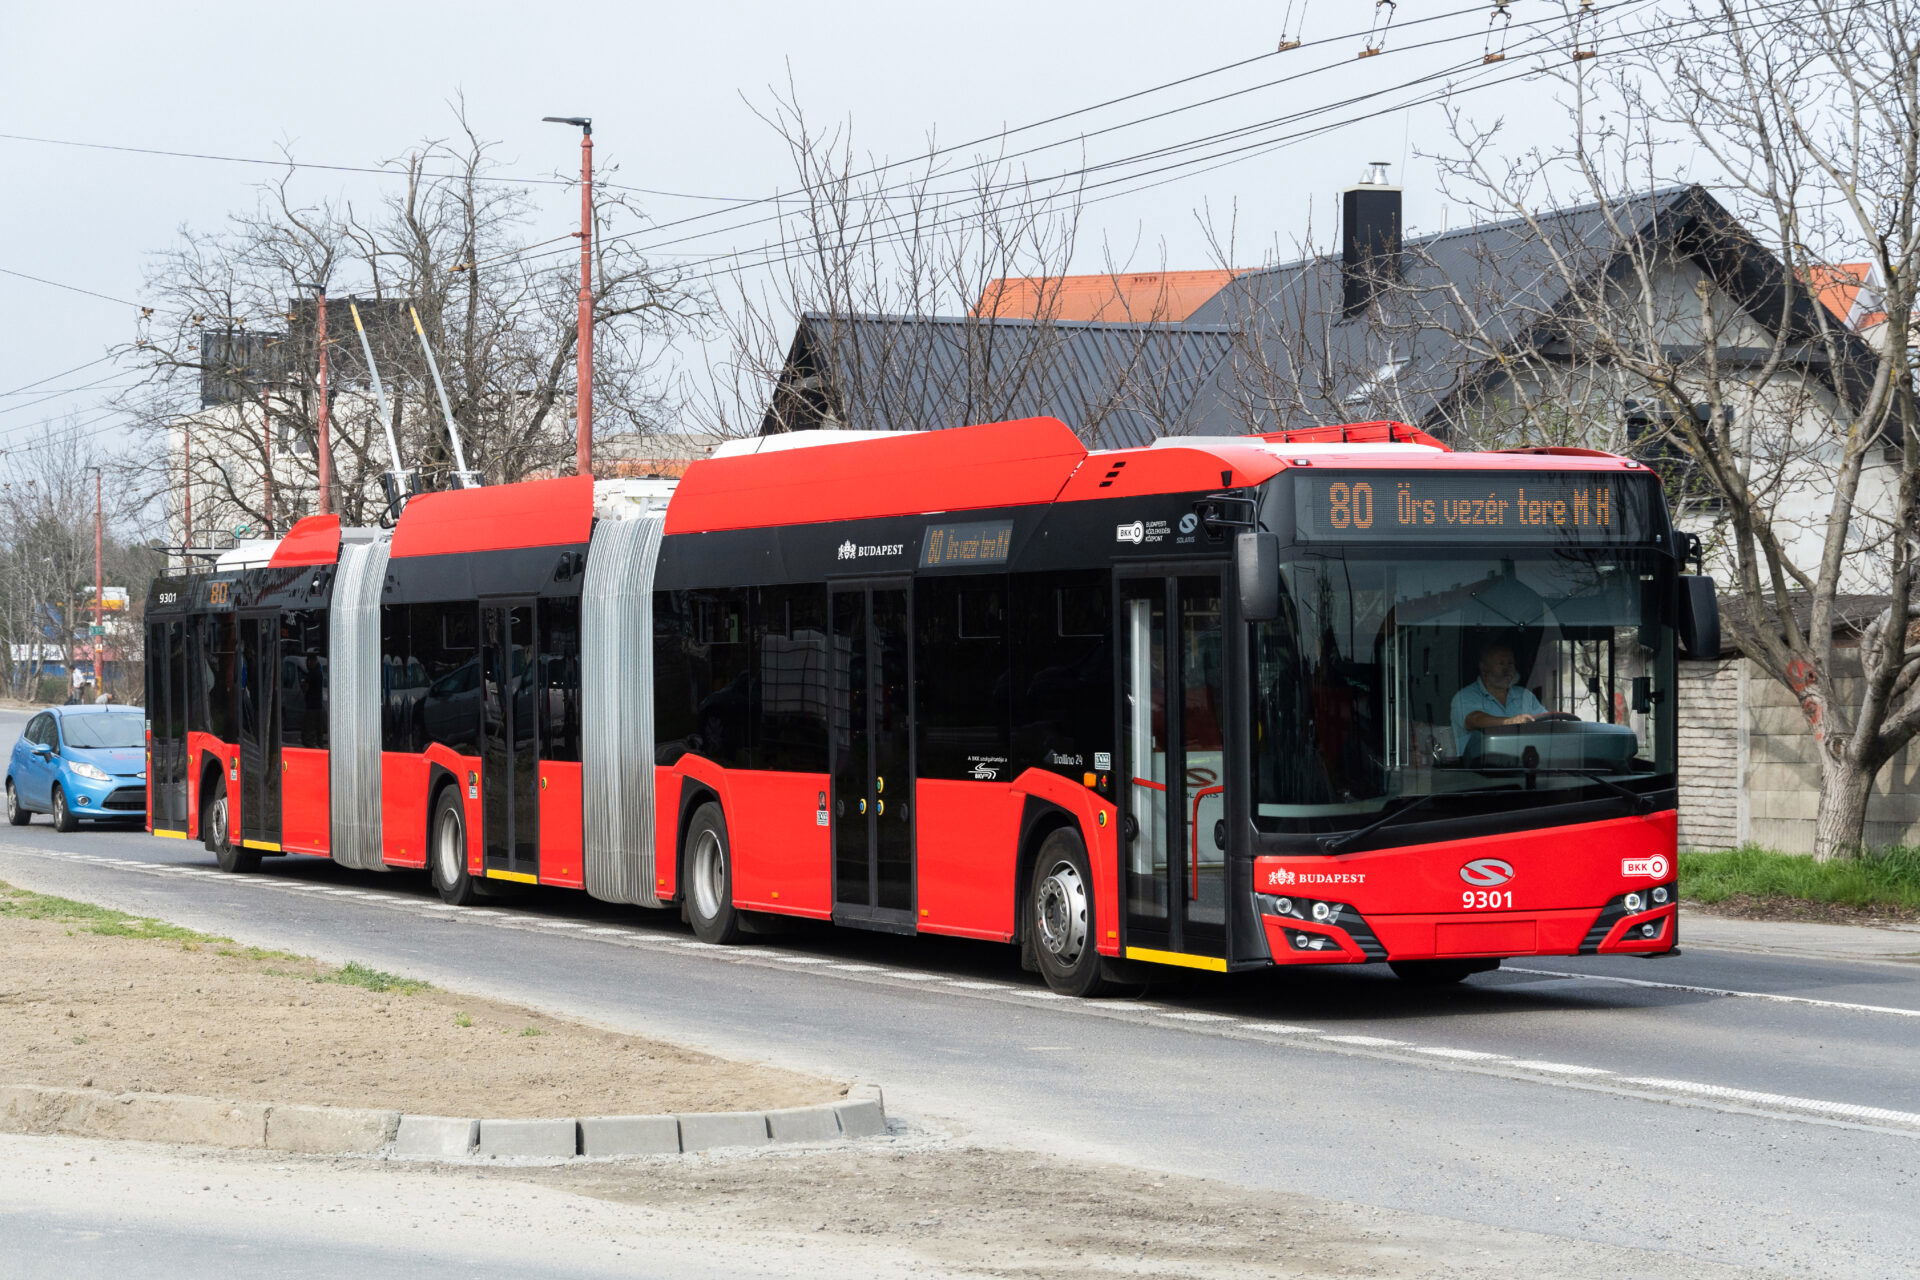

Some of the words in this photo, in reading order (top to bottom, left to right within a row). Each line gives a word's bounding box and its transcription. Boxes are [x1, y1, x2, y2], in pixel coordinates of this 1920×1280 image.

[1329, 482, 1373, 528] 80
[1397, 482, 1436, 525] Örs
[1443, 493, 1509, 525] vezér
[1517, 488, 1566, 525] tere
[1120, 529, 1132, 537] BKK
[927, 529, 944, 564] 80
[1176, 536, 1196, 544] SOLARIS
[858, 544, 904, 557] BUDAPEST
[159, 592, 177, 604] 9301
[210, 582, 228, 604] 80
[1052, 753, 1075, 765] Trollino
[1075, 754, 1083, 766] 24
[1627, 863, 1648, 872] BKK
[1299, 873, 1366, 884] BUDAPEST
[1462, 890, 1513, 909] 9301
